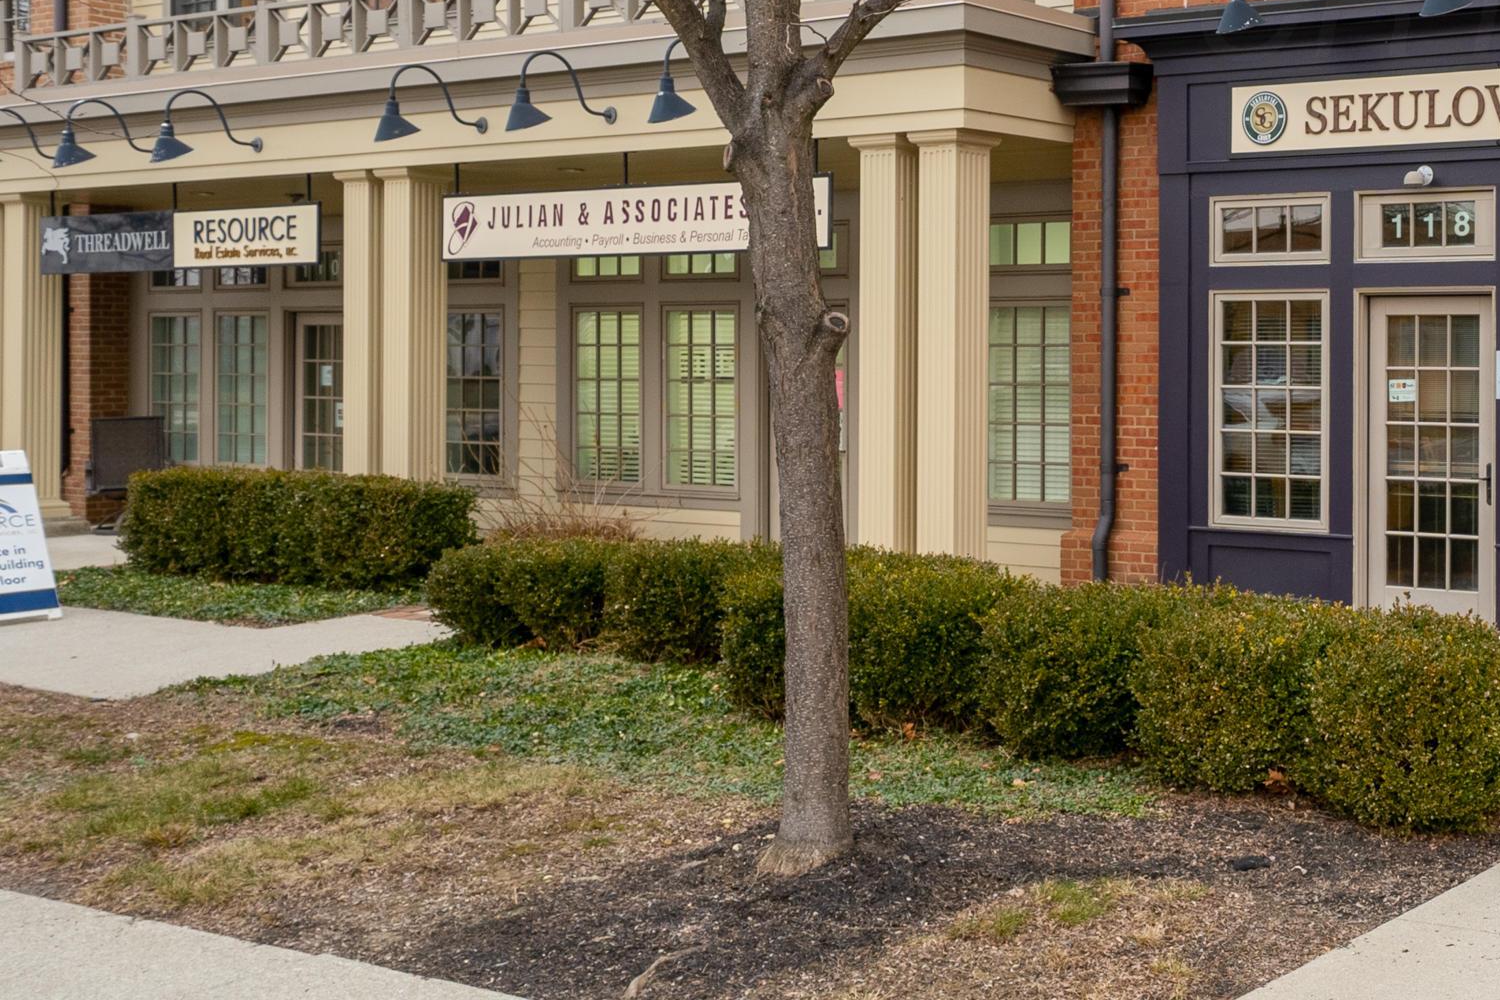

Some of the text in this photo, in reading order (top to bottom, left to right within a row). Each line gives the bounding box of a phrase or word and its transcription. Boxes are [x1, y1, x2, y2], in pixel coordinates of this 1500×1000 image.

[487, 203, 564, 230] JULIAN
[578, 202, 590, 226] &
[1391, 211, 1470, 238] 118
[193, 215, 297, 244] RESOURCE
[531, 235, 583, 250] Accounting
[591, 233, 624, 249] Payroll
[632, 231, 677, 246] Business
[679, 229, 687, 243] &
[688, 228, 734, 243] Personal
[75, 230, 170, 253] THREADWELL
[194, 245, 213, 259] Real
[215, 245, 241, 259] Estate
[14, 545, 27, 555] in
